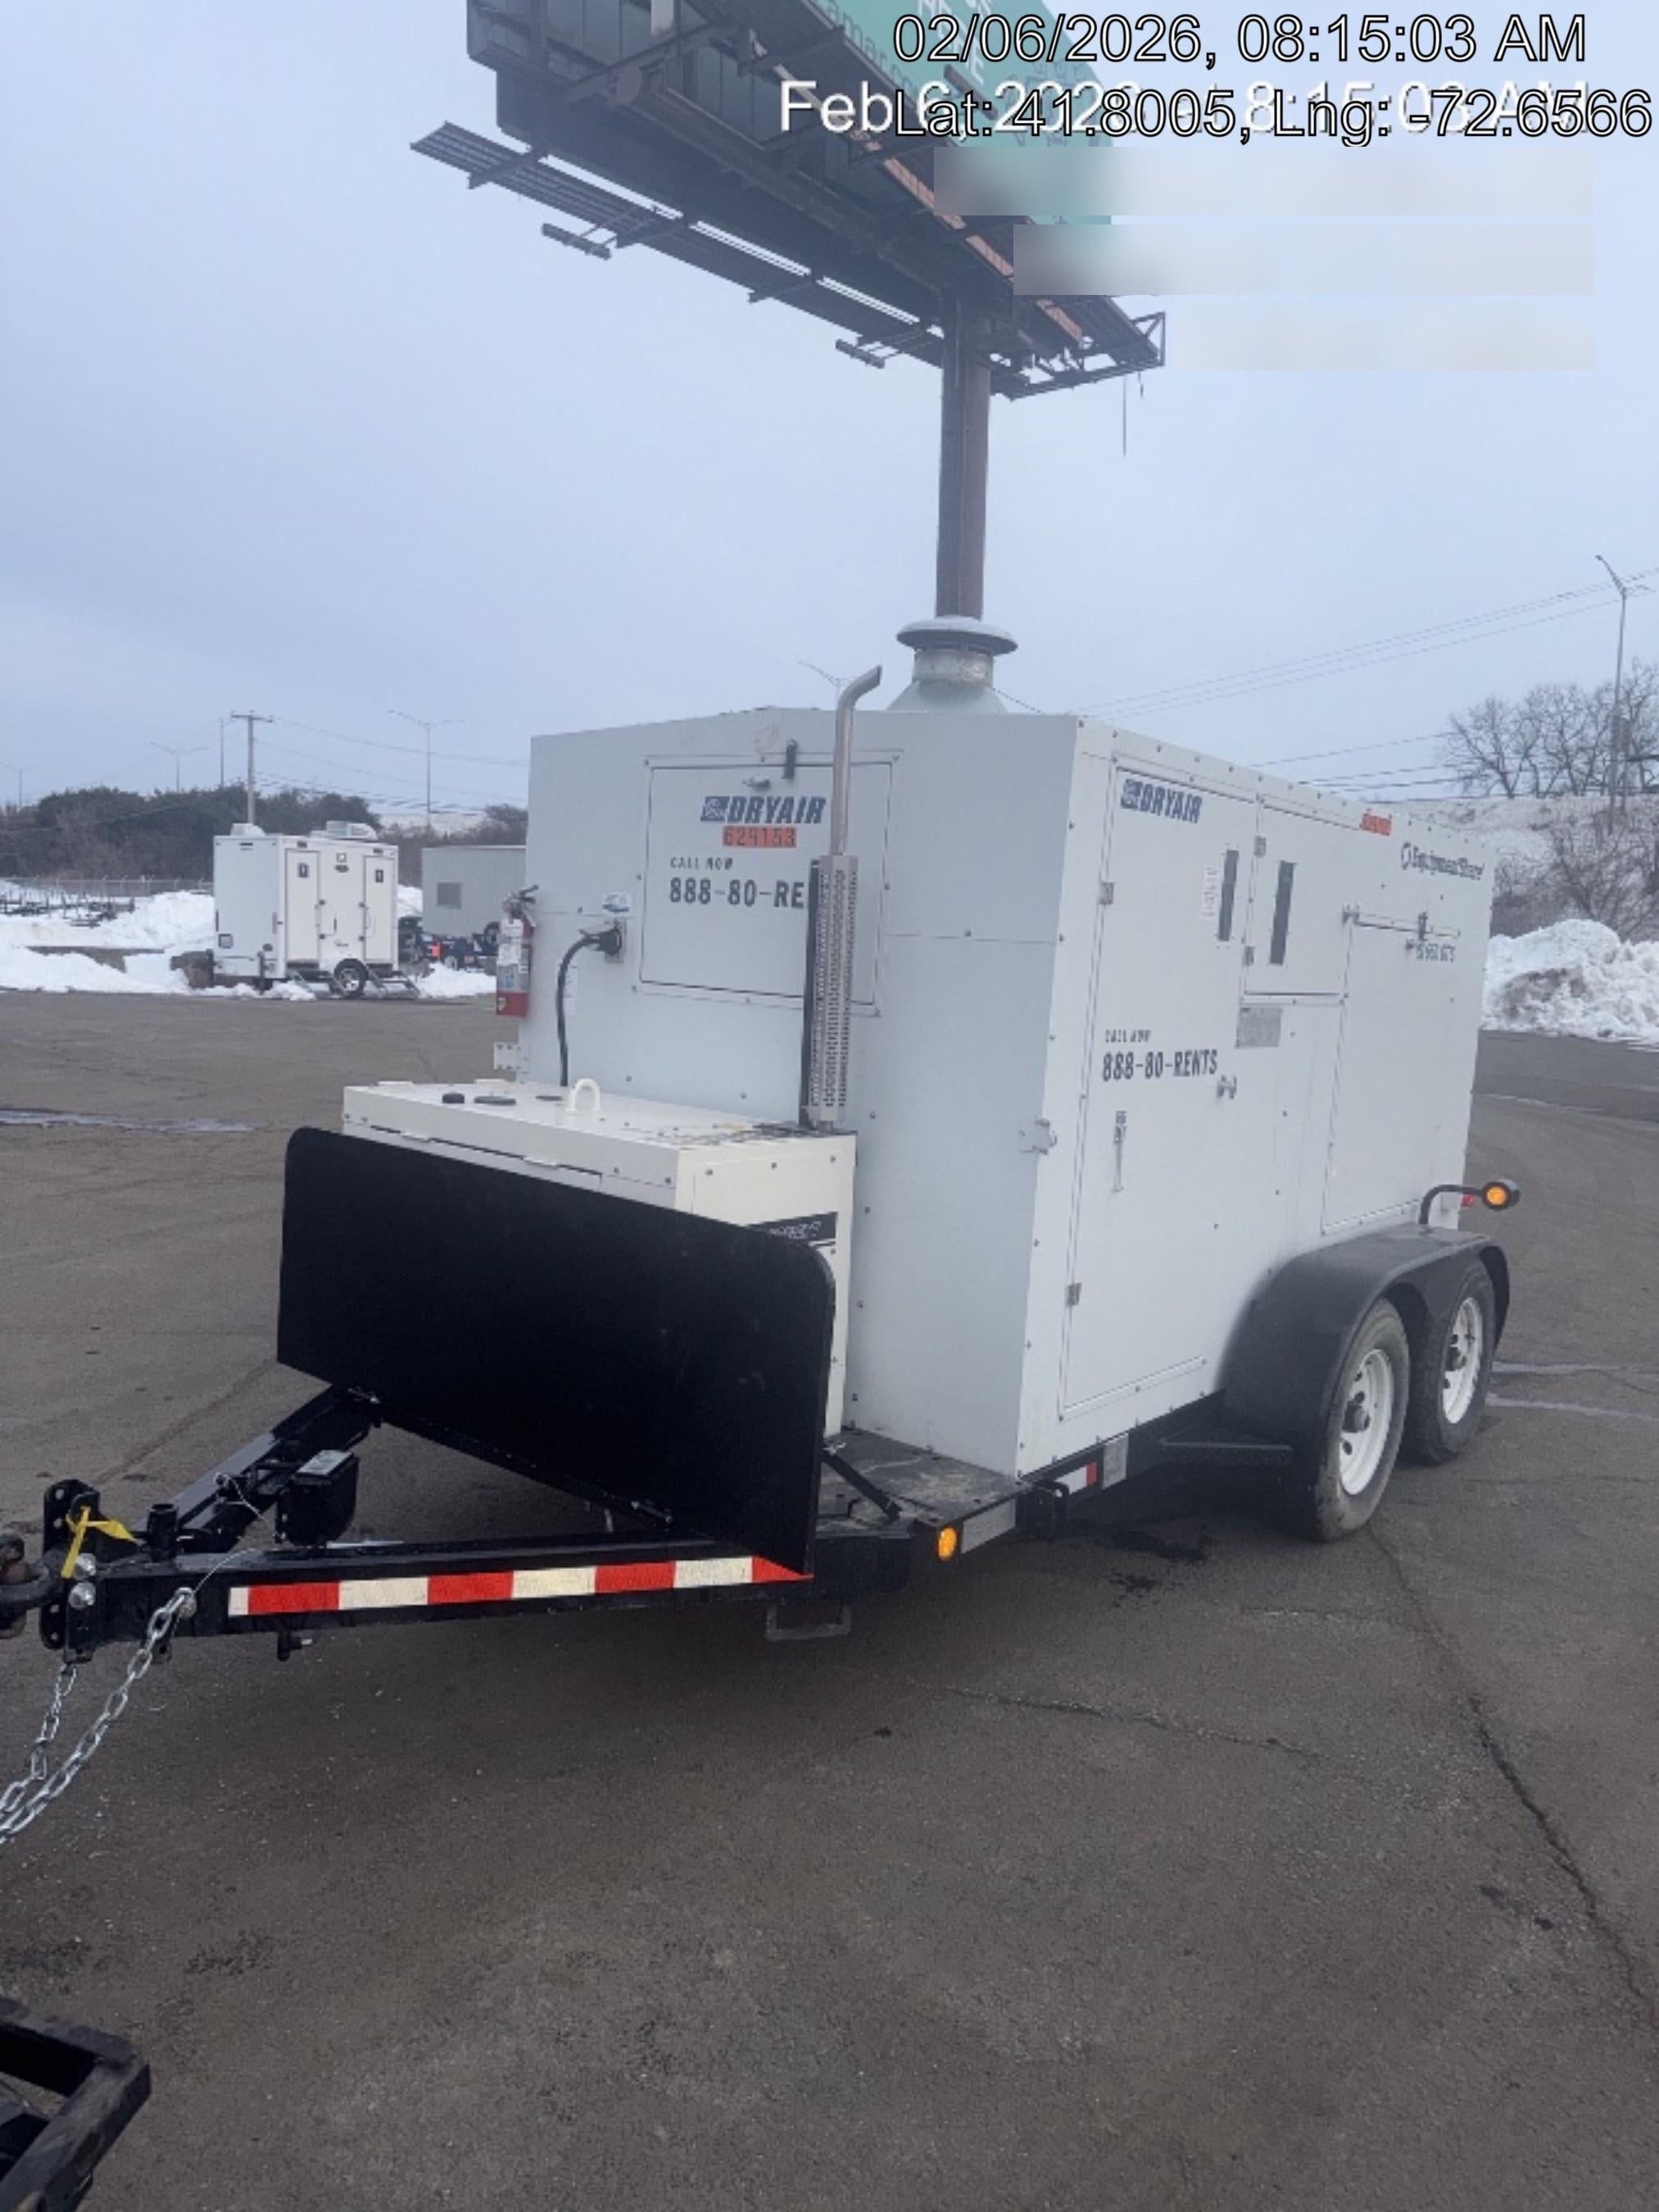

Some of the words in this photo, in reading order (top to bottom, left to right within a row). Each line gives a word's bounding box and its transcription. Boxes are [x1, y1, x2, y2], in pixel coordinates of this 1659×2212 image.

[725, 796, 827, 824] DRYAIR
[1140, 782, 1203, 824] DRYAIR
[669, 857, 700, 870] CALL
[1102, 1049, 1218, 1082] 888-80-RENTS
